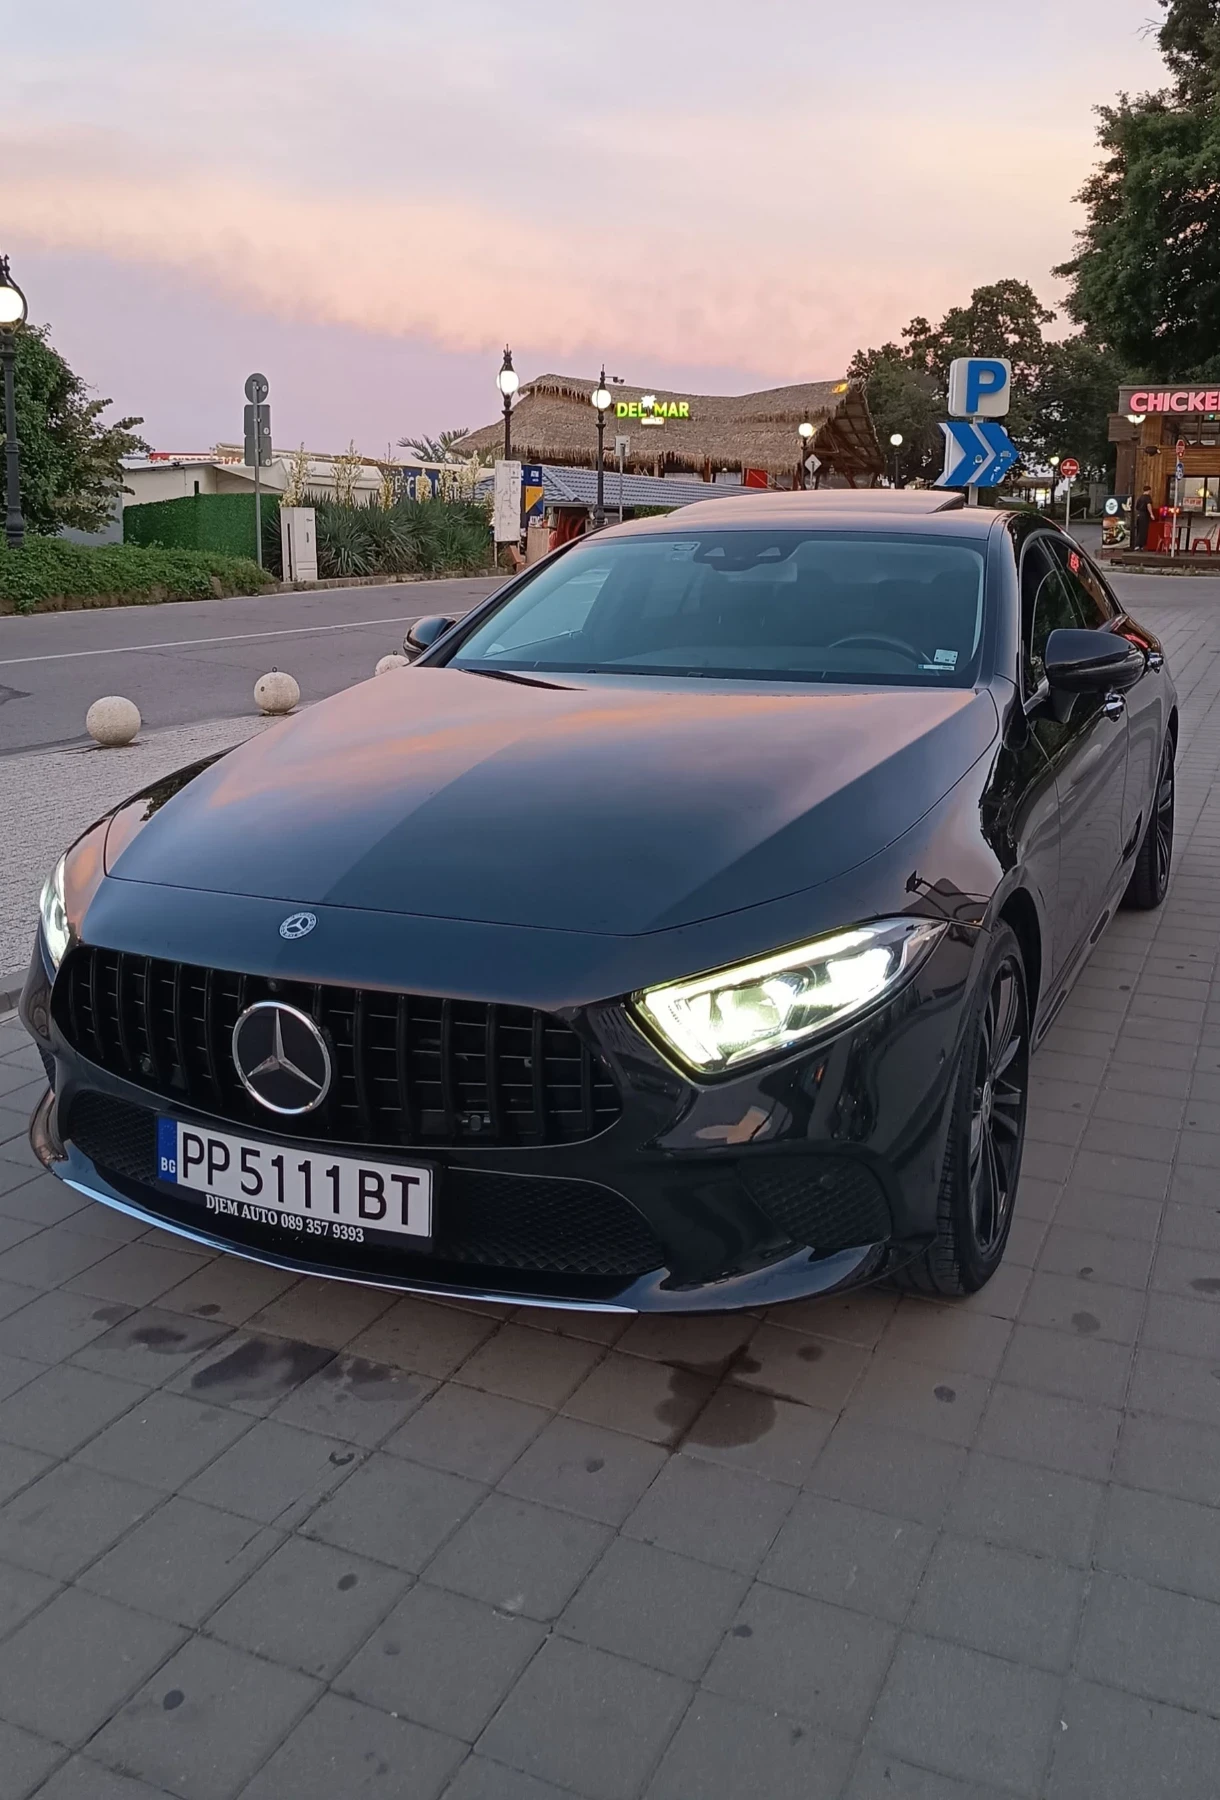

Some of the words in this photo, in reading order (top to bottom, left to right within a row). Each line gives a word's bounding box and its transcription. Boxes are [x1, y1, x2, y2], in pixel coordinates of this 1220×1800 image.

[966, 360, 1007, 414] P
[1130, 391, 1220, 412] CHICKE
[617, 402, 647, 417] DEL
[654, 402, 689, 417] MAR
[161, 1157, 176, 1173] BG
[183, 1132, 231, 1186] PP
[241, 1146, 340, 1215] 5111
[359, 1168, 420, 1226] BT
[205, 1194, 238, 1215] DJEM
[241, 1204, 277, 1225] AUTO
[281, 1213, 303, 1231] 089
[306, 1218, 329, 1236] 357
[333, 1223, 364, 1243] 9393
